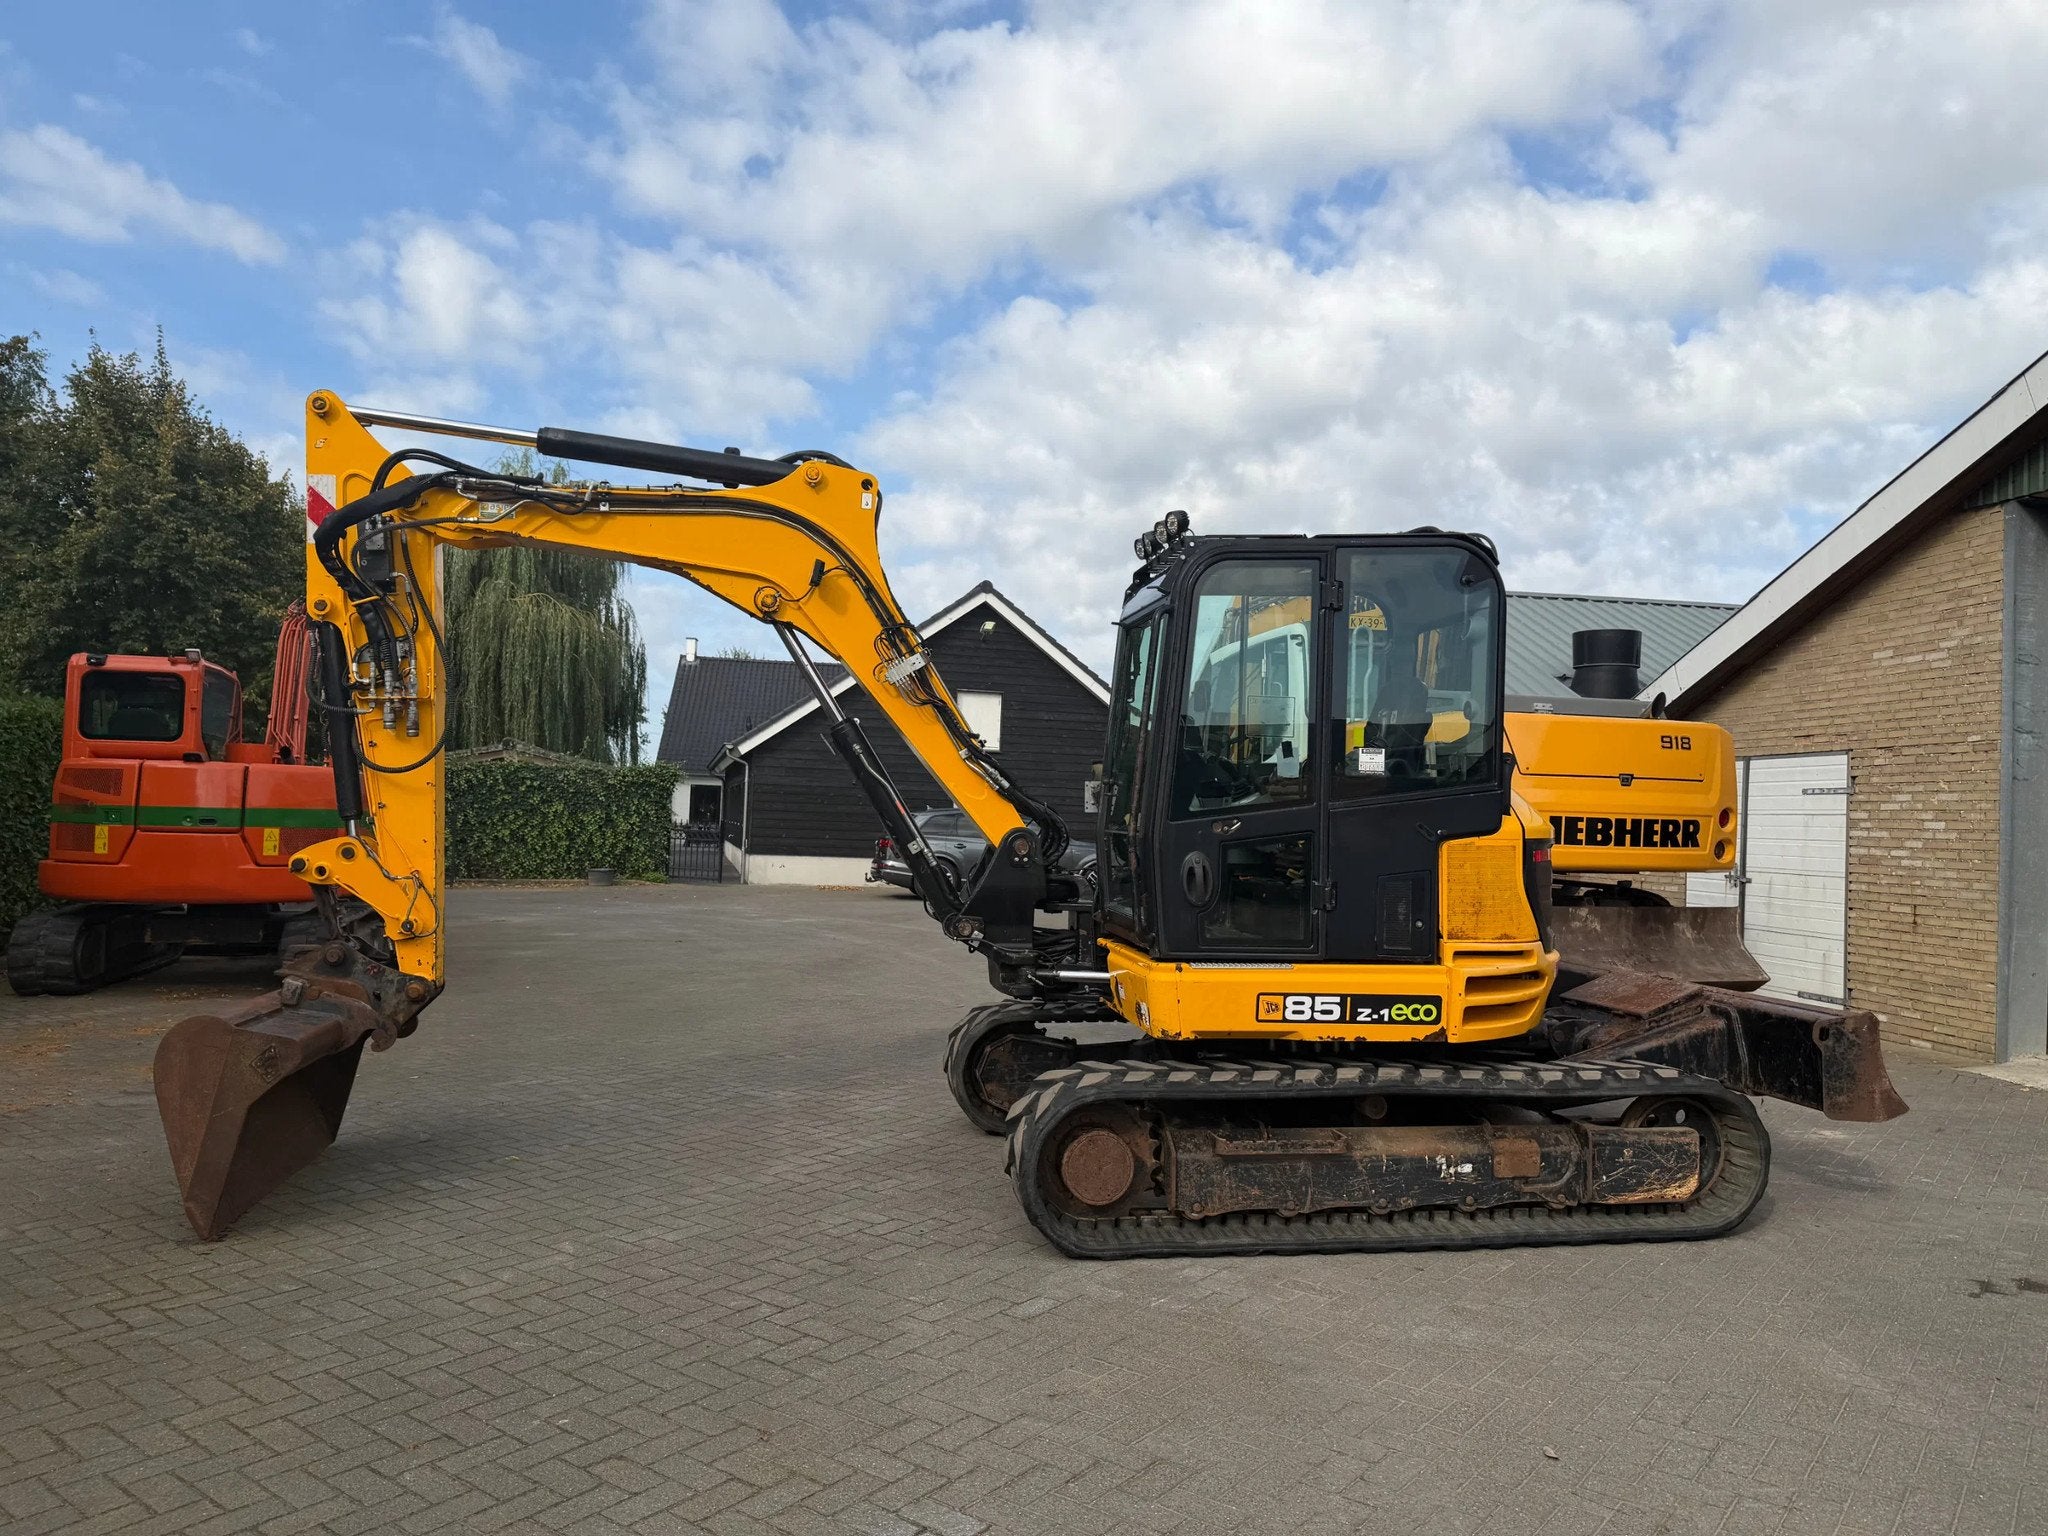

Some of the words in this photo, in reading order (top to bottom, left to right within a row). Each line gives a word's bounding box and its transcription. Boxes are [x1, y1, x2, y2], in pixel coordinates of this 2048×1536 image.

[1660, 735, 1692, 750] 918
[1549, 815, 1700, 848] IEBHERR
[1284, 995, 1341, 1021] 85
